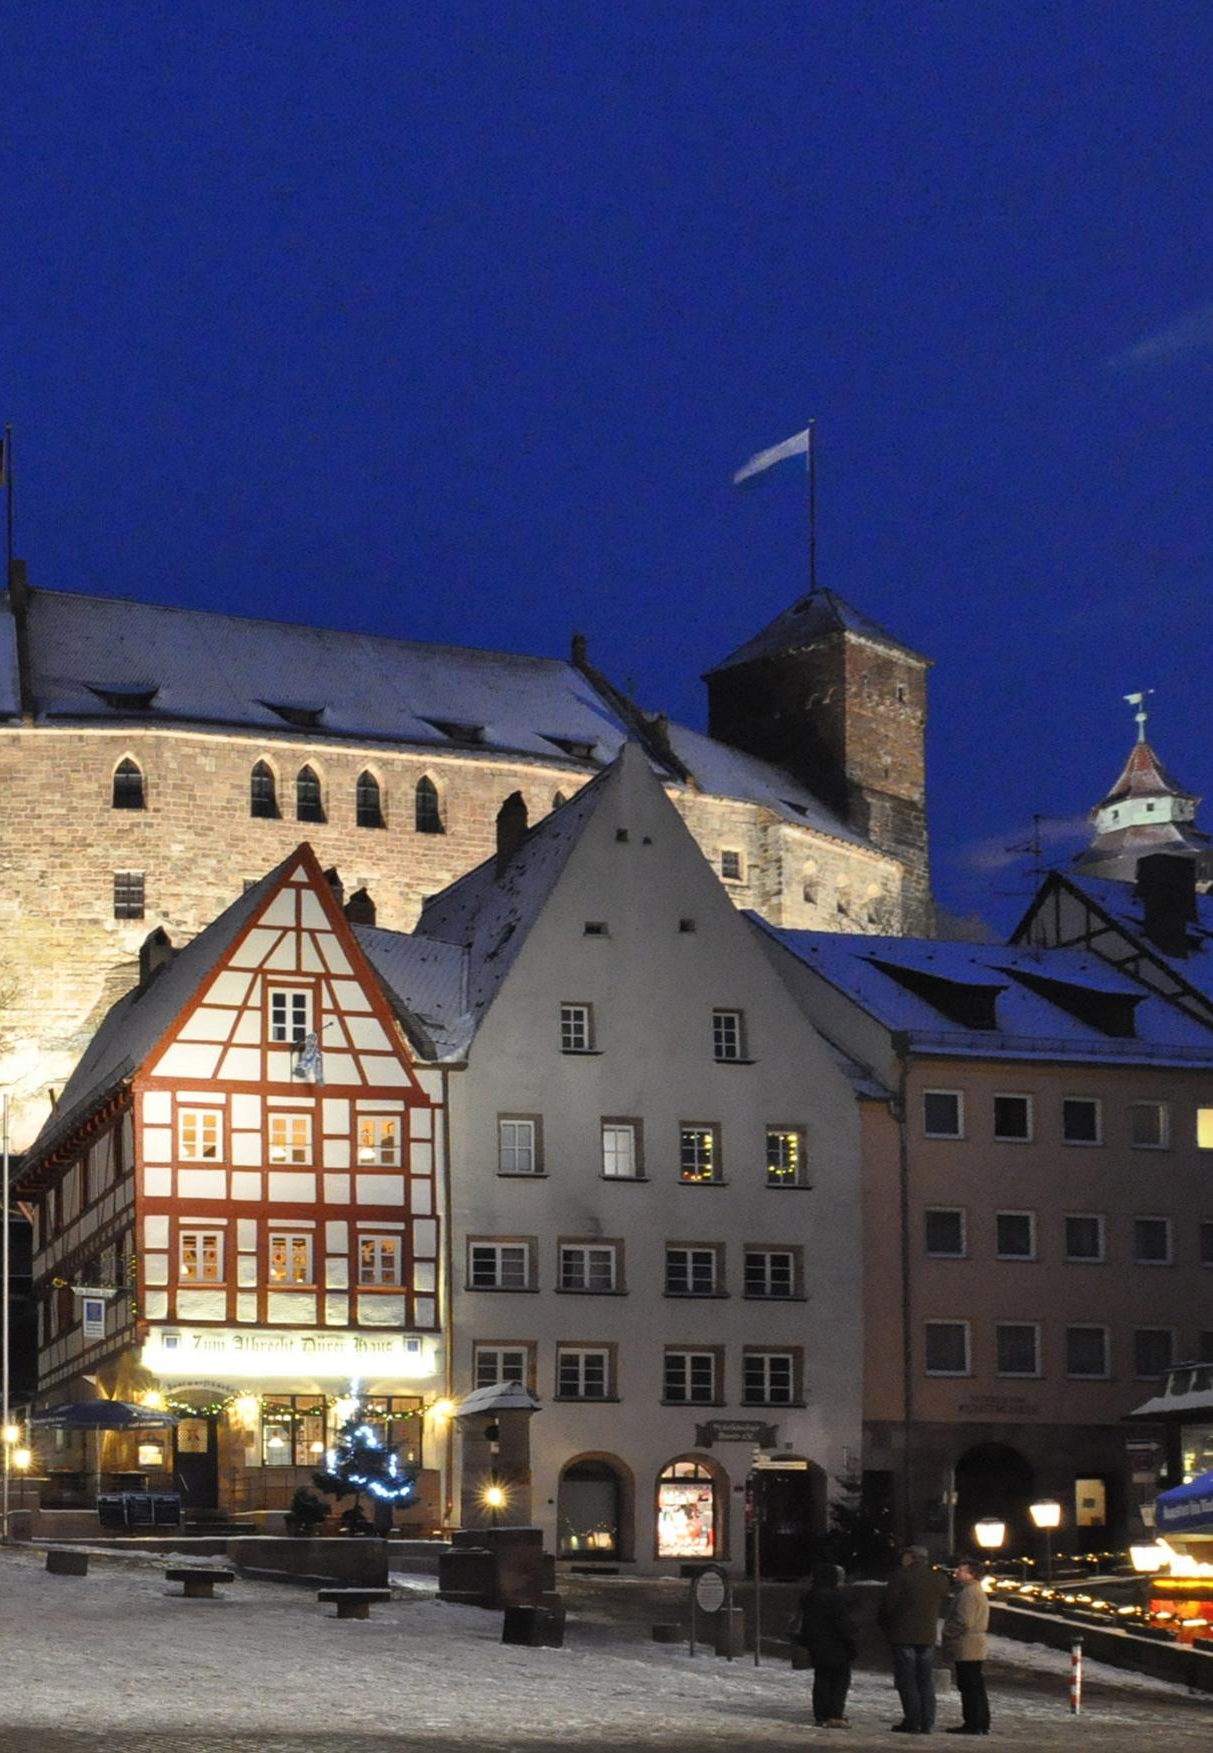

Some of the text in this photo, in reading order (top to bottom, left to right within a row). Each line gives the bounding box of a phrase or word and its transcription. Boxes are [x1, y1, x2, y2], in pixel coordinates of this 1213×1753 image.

[192, 1334, 393, 1354] Zum Albrecht Dürer Haus
